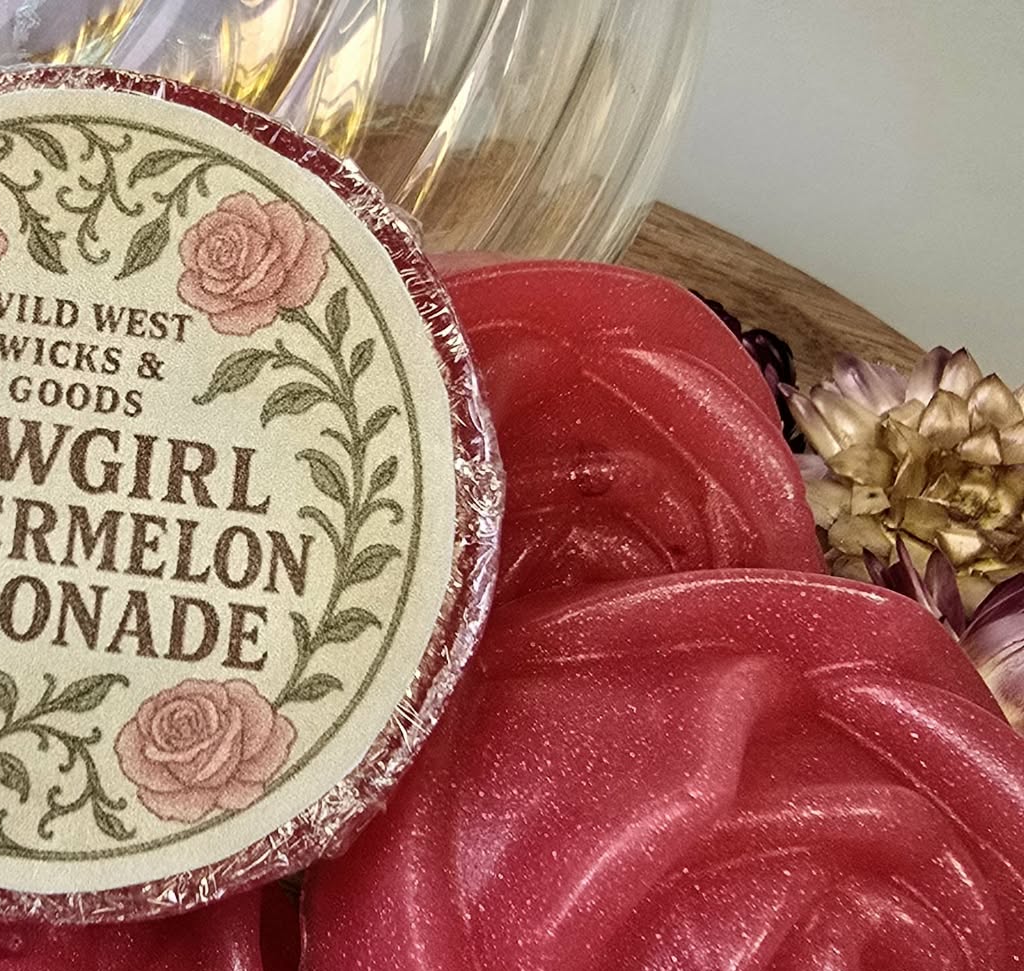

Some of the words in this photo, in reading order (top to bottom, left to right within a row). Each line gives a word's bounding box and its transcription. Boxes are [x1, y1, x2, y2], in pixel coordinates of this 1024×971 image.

[93, 303, 193, 343] WEST
[137, 351, 165, 382] &
[9, 376, 143, 418] GOODS
